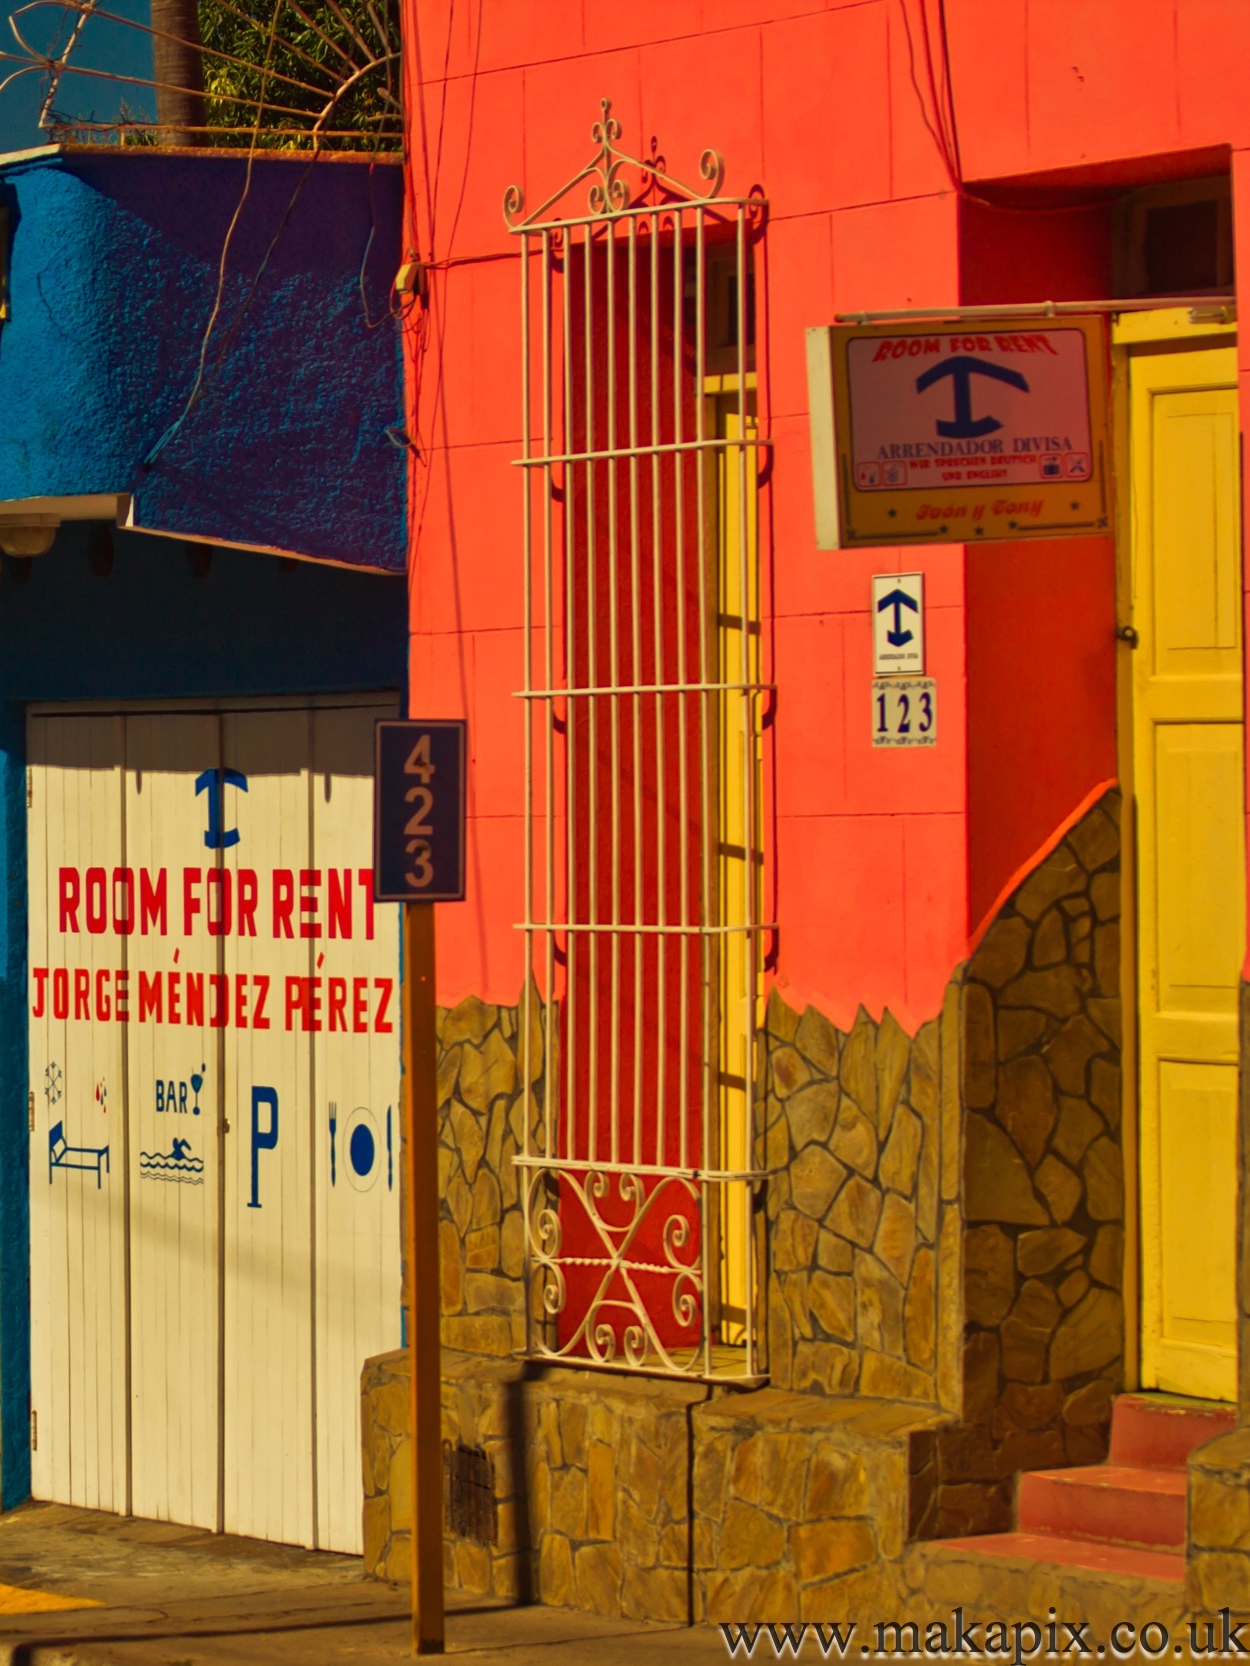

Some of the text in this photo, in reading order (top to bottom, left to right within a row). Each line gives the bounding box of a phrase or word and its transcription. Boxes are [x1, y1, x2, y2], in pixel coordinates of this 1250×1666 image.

[872, 333, 1059, 362] ROOM FOR RENT
[877, 436, 1073, 460] ARRENDADOR DIVISA
[972, 502, 987, 521] y
[992, 499, 1044, 517] Tony
[876, 691, 933, 733] 123
[58, 867, 375, 940] ROOM FOR RENT
[32, 947, 393, 1034] JORGE MÉNDEZ PÉREZ
[155, 1079, 188, 1114] BAR
[247, 1085, 279, 1208] P
